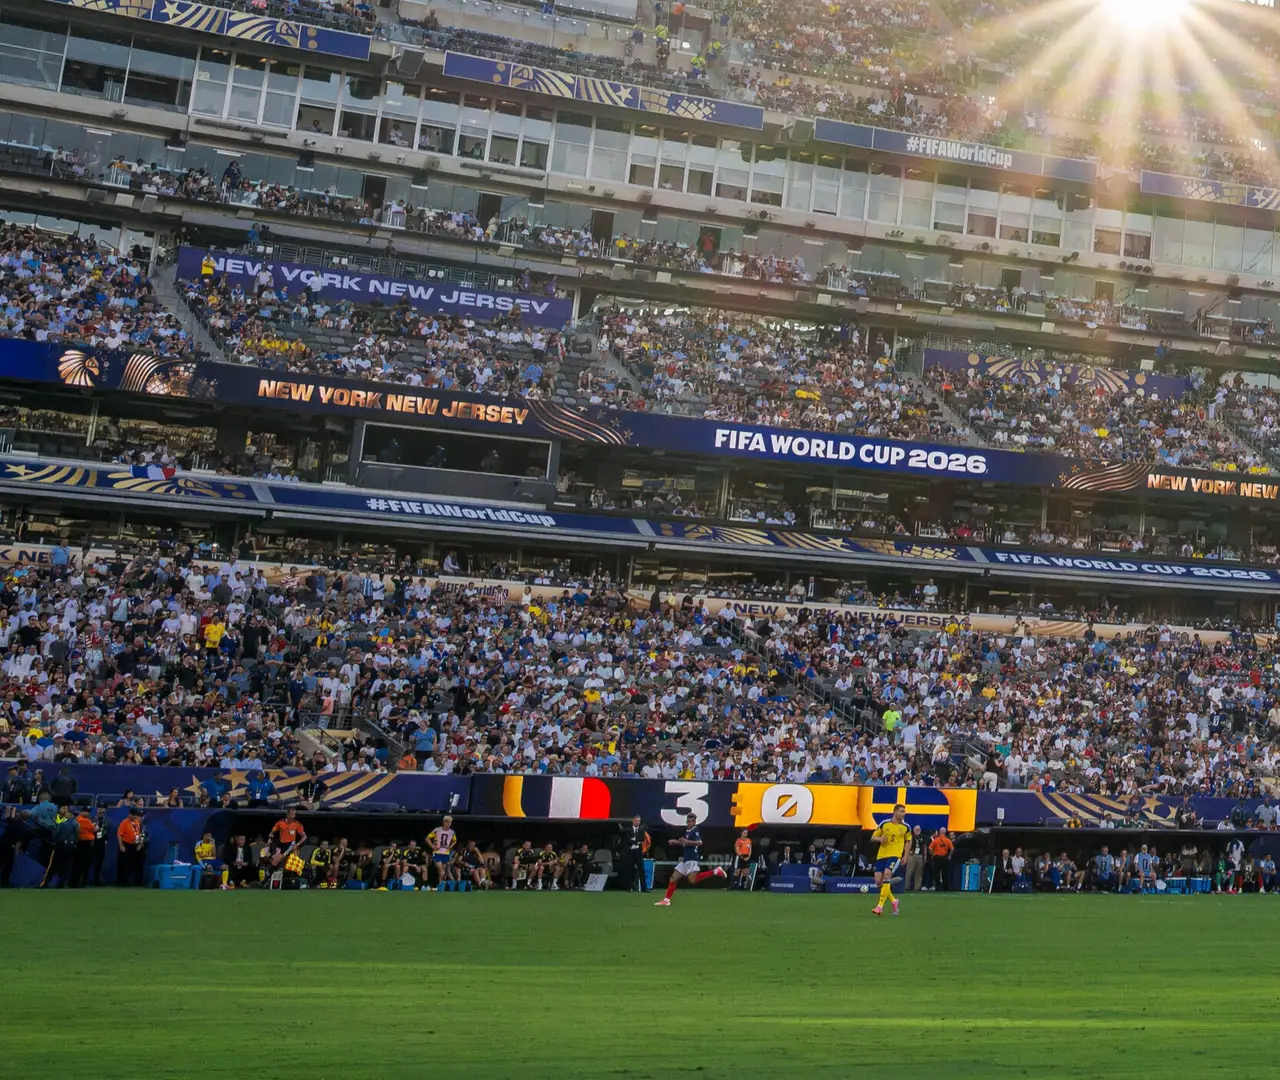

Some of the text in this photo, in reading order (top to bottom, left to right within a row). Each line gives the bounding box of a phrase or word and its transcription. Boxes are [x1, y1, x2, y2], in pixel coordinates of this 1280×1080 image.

[906, 136, 1012, 169] #FIFAWorldCup
[213, 257, 550, 315] NEW YORK NEW JERSEY
[258, 379, 529, 425] NEW YORK NEW JERSEY
[715, 428, 987, 474] FIFA WORLD CUP 2026
[1147, 474, 1188, 491] NEW
[1190, 477, 1237, 496] YORK
[1239, 482, 1279, 499] NEW
[366, 498, 556, 527] #FIFAWorldCup
[995, 552, 1271, 580] FIFA WORLD CUP 2026
[733, 603, 779, 616] NEW
[661, 781, 709, 827] 3
